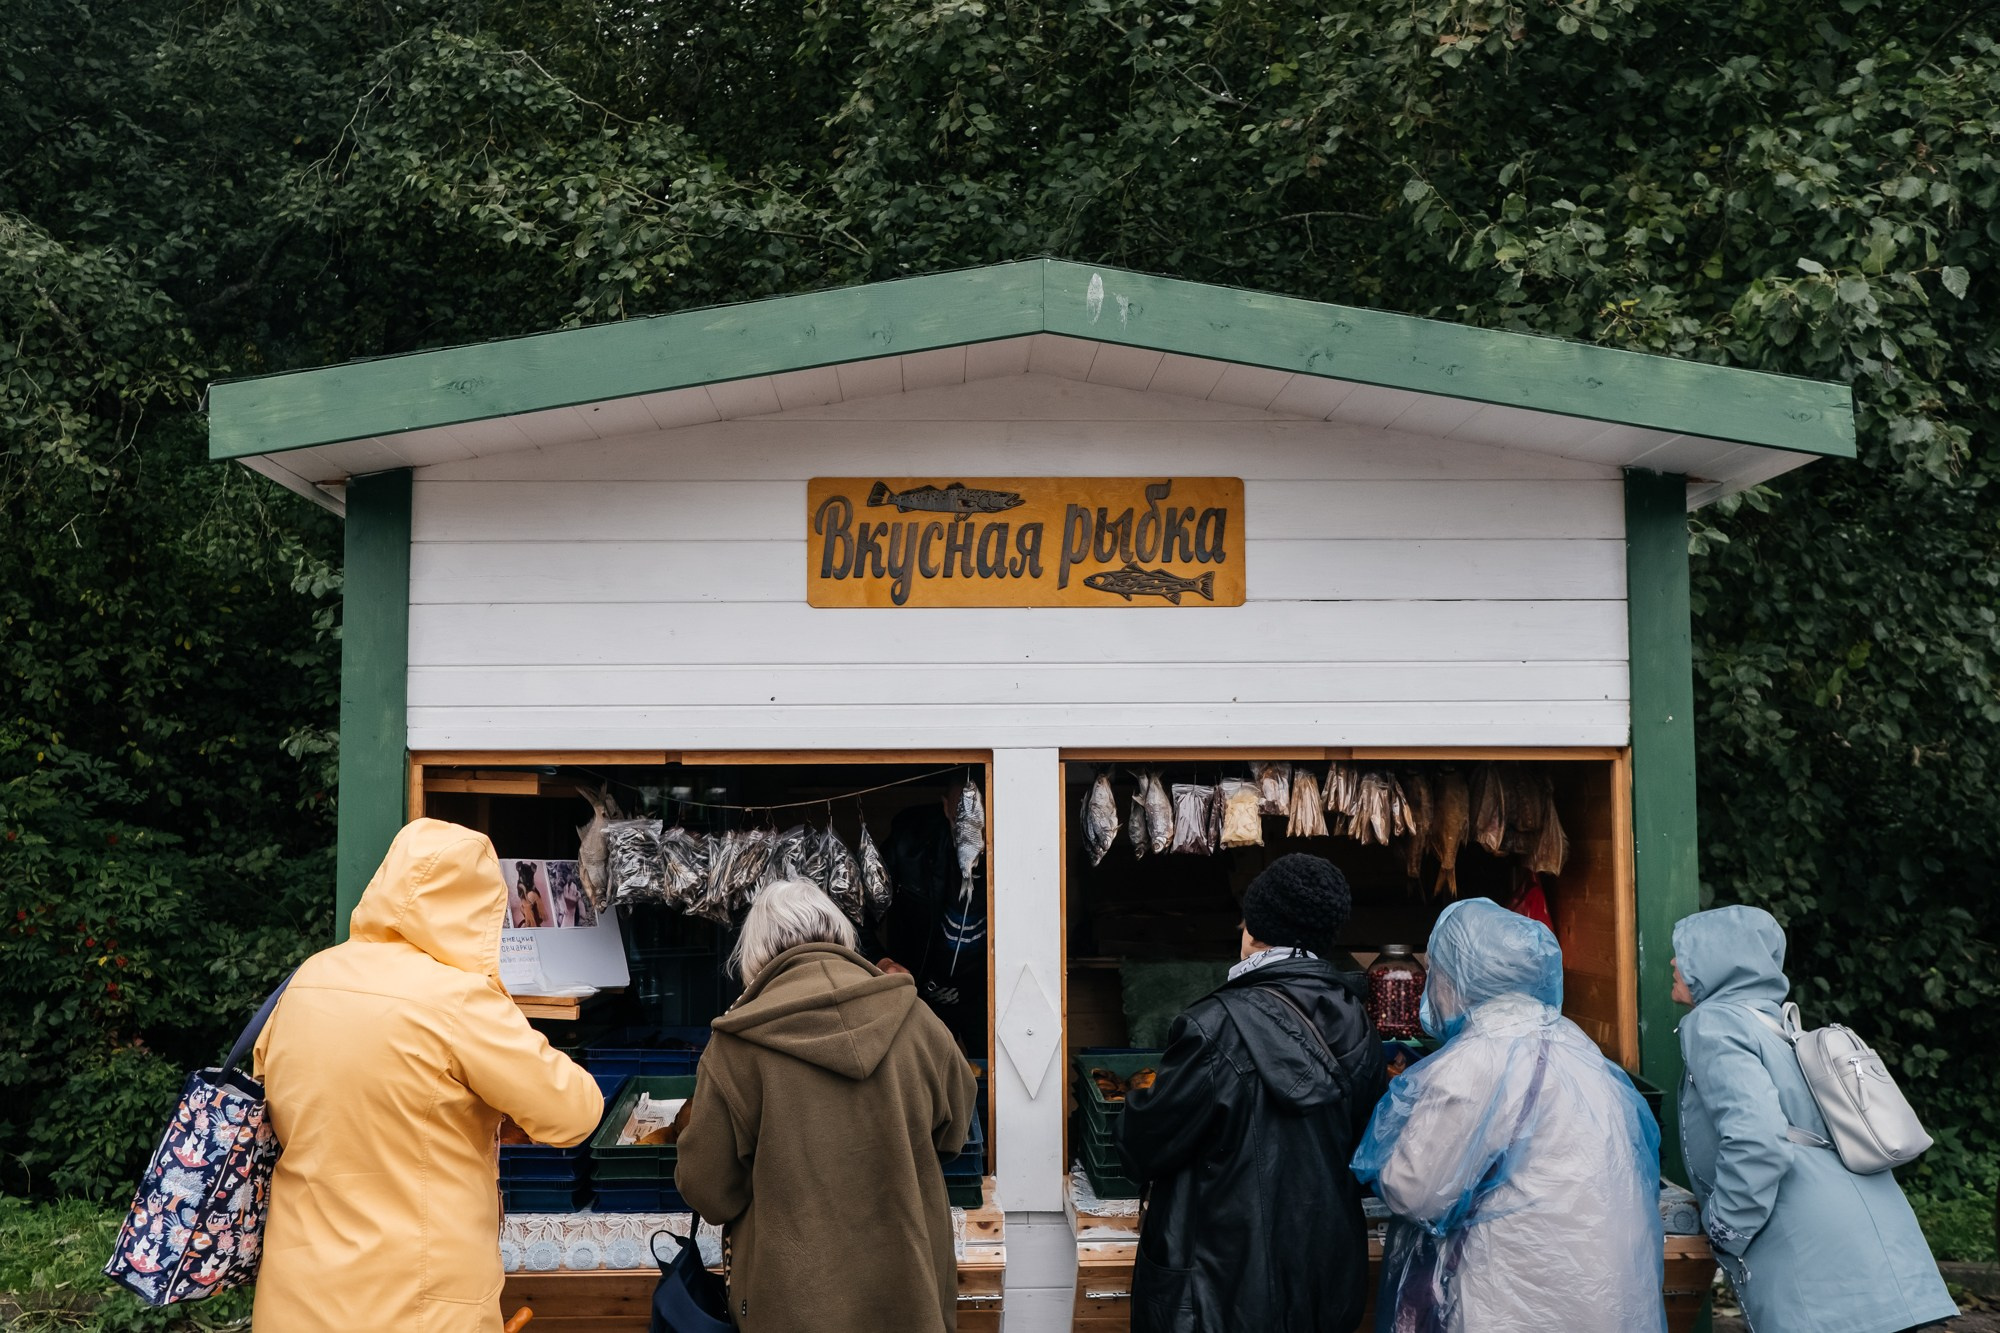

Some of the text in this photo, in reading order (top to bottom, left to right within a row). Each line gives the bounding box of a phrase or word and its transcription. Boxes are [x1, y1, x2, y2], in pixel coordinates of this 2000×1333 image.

[815, 479, 1227, 606] Вкусная рыбка
[501, 936, 534, 944] ЕМЕЦКИЕ
